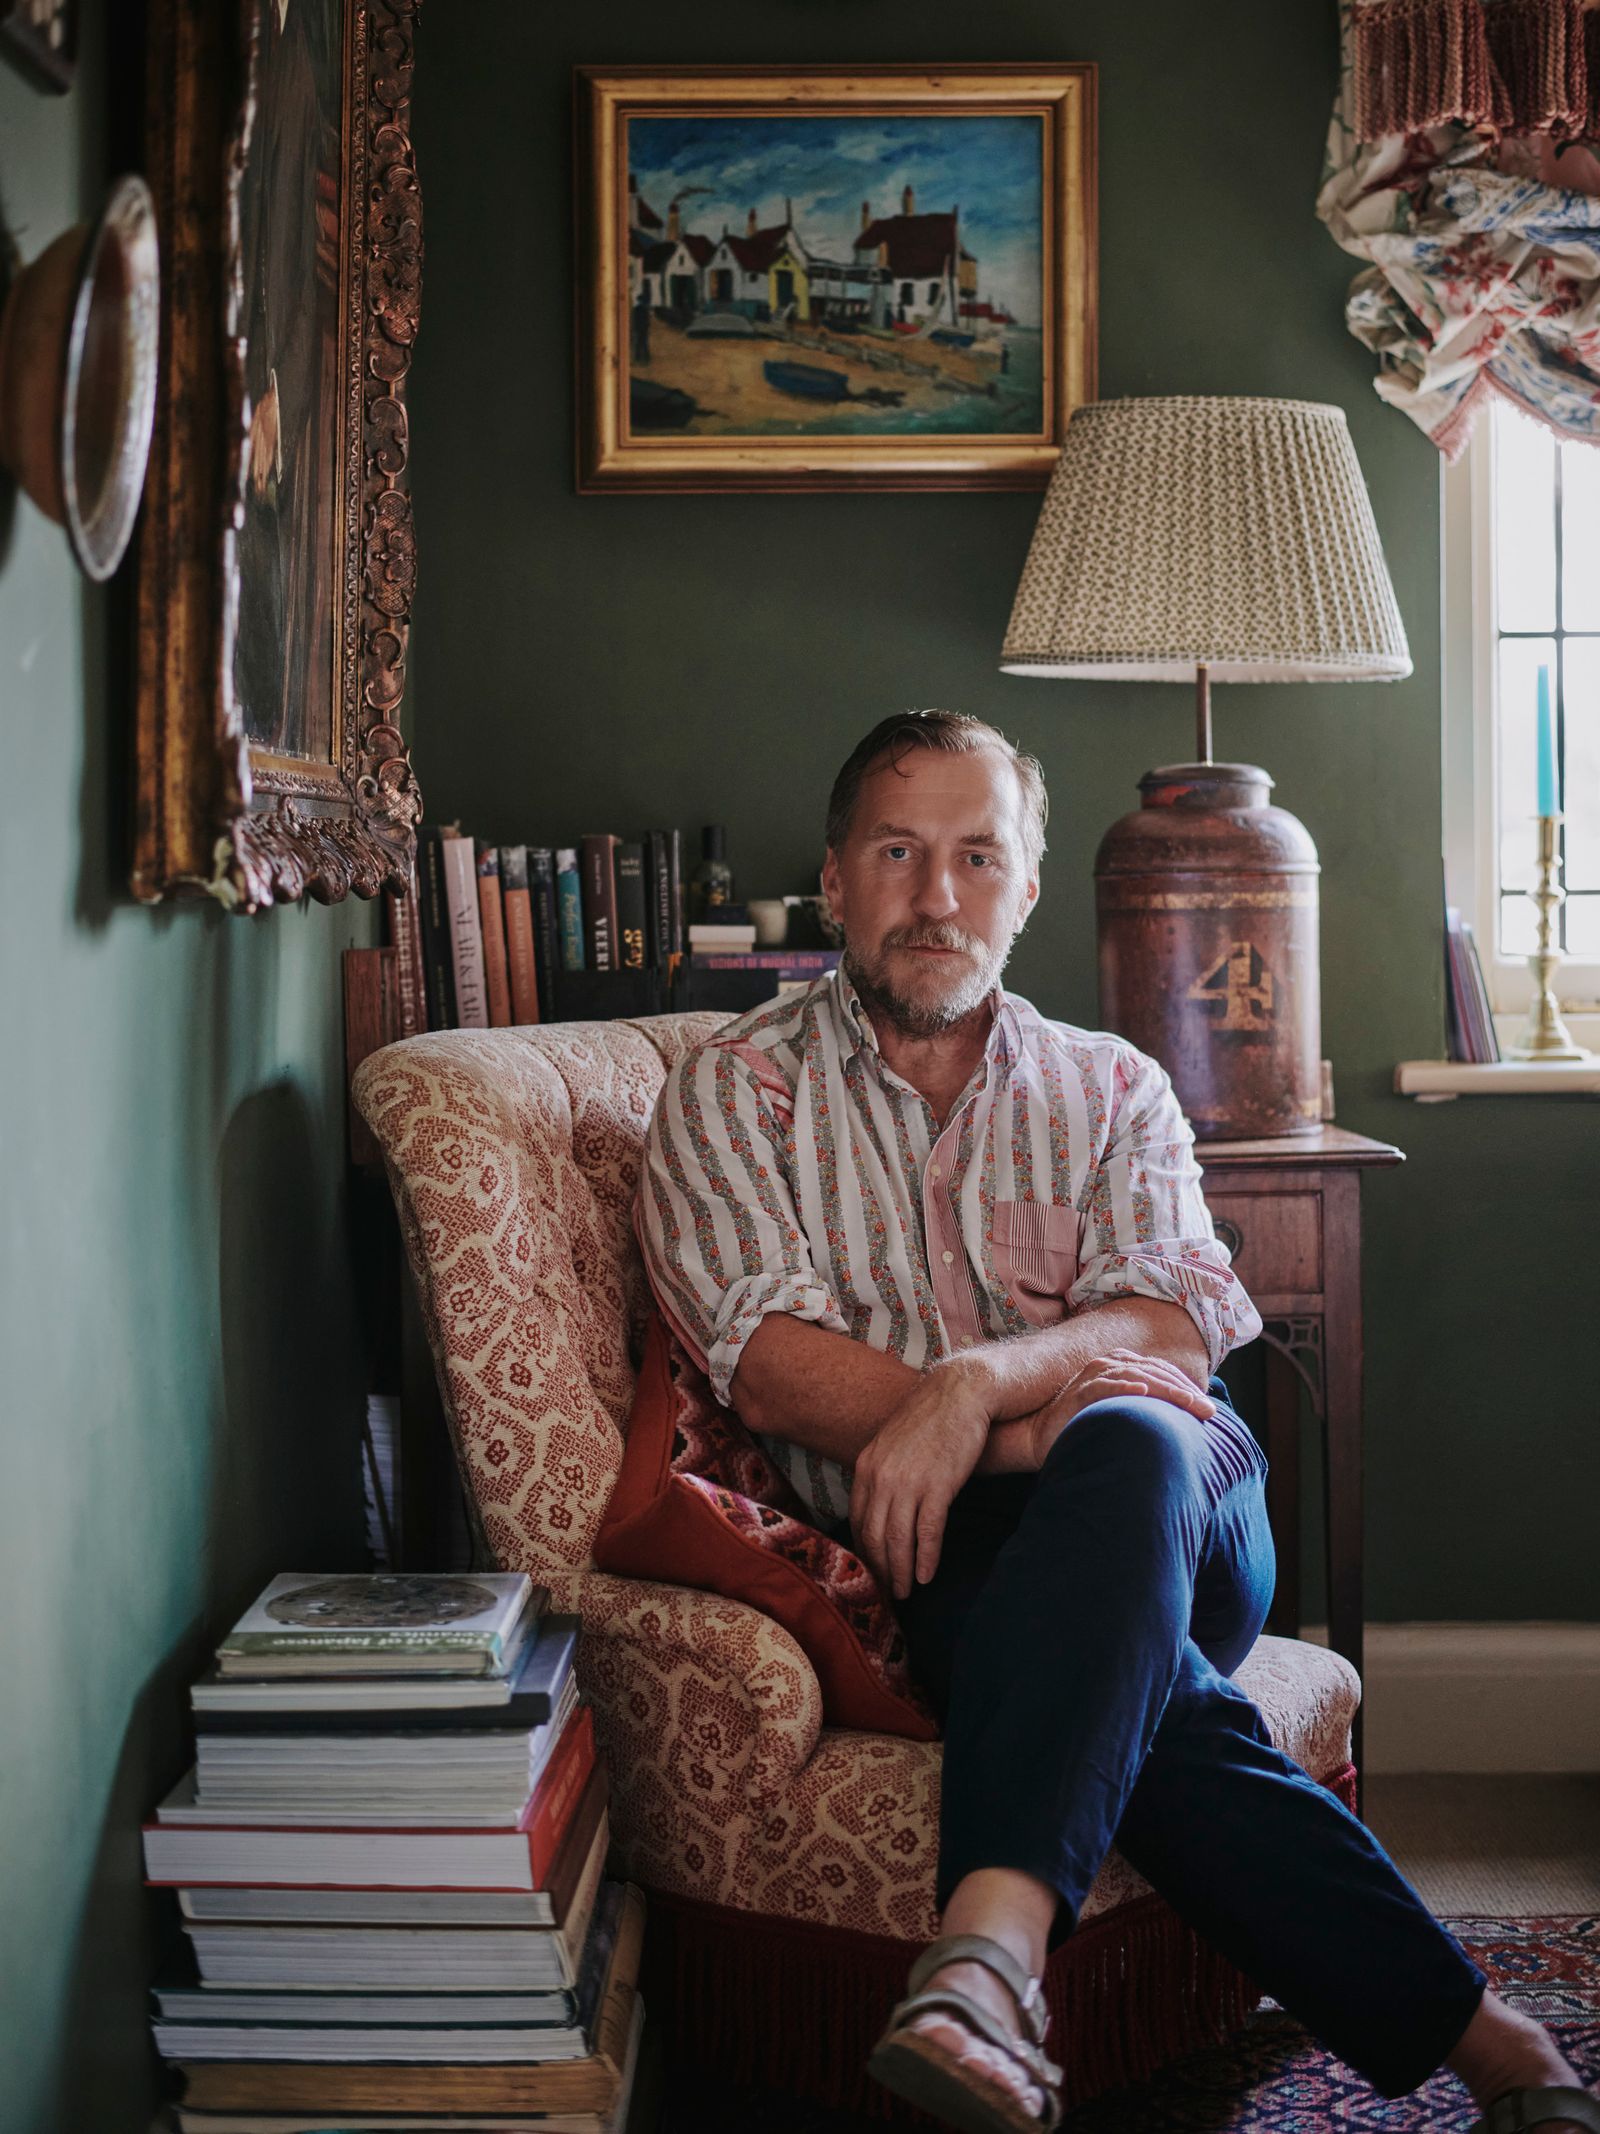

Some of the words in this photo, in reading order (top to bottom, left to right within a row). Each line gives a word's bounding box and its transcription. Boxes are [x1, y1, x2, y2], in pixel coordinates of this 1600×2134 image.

[658, 867, 669, 917] ENGLISH
[563, 892, 577, 933] Perfect
[456, 905, 475, 959] NEAR
[708, 957, 745, 969] VISIONS
[798, 956, 824, 968] INDIA
[460, 965, 475, 977] &
[1186, 941, 1274, 1032] 4
[461, 982, 481, 1020] FAR
[389, 1631, 492, 1639] Ceramics
[273, 1636, 372, 1647] Japanese
[374, 1637, 403, 1646] of
[406, 1637, 440, 1646] Art
[446, 1637, 485, 1646] The
